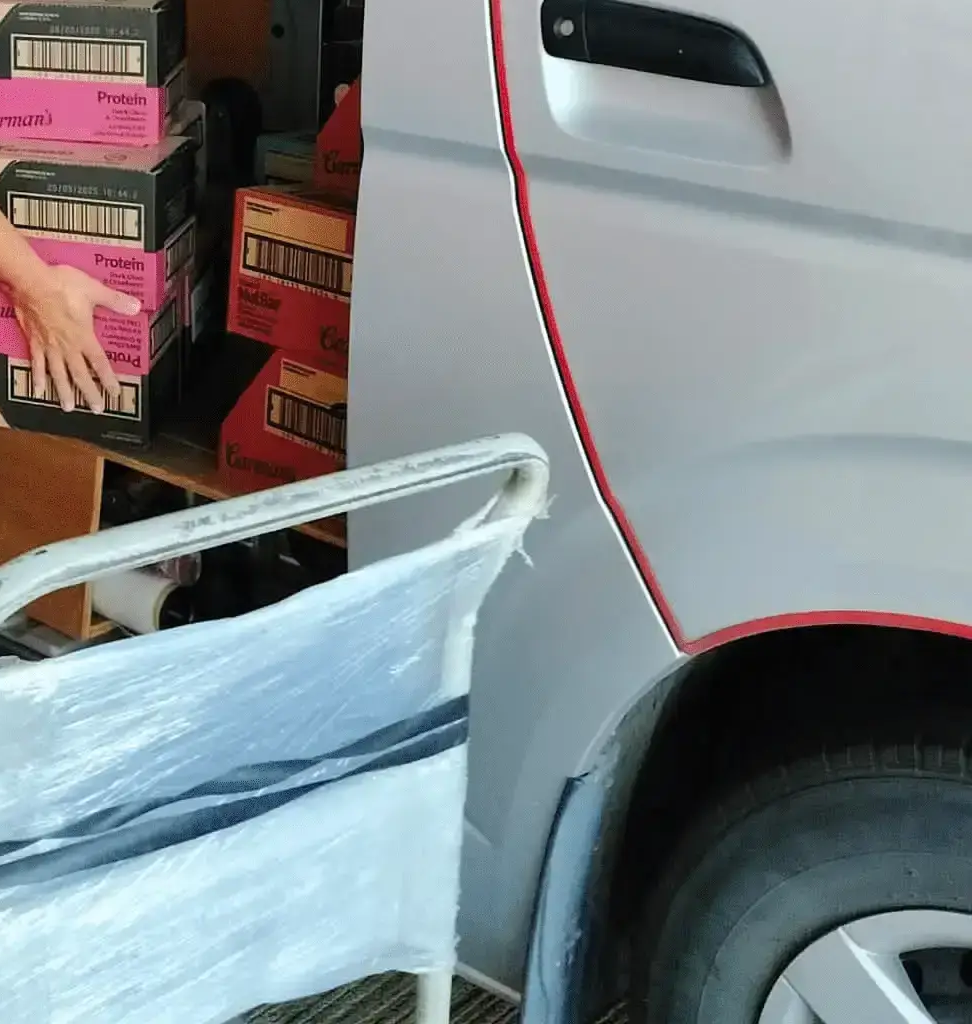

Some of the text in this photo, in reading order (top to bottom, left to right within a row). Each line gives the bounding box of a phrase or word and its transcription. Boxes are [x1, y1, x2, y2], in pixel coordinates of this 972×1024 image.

[97, 90, 147, 106] Protein
[94, 253, 145, 272] Protein
[106, 350, 142, 369] Prote
